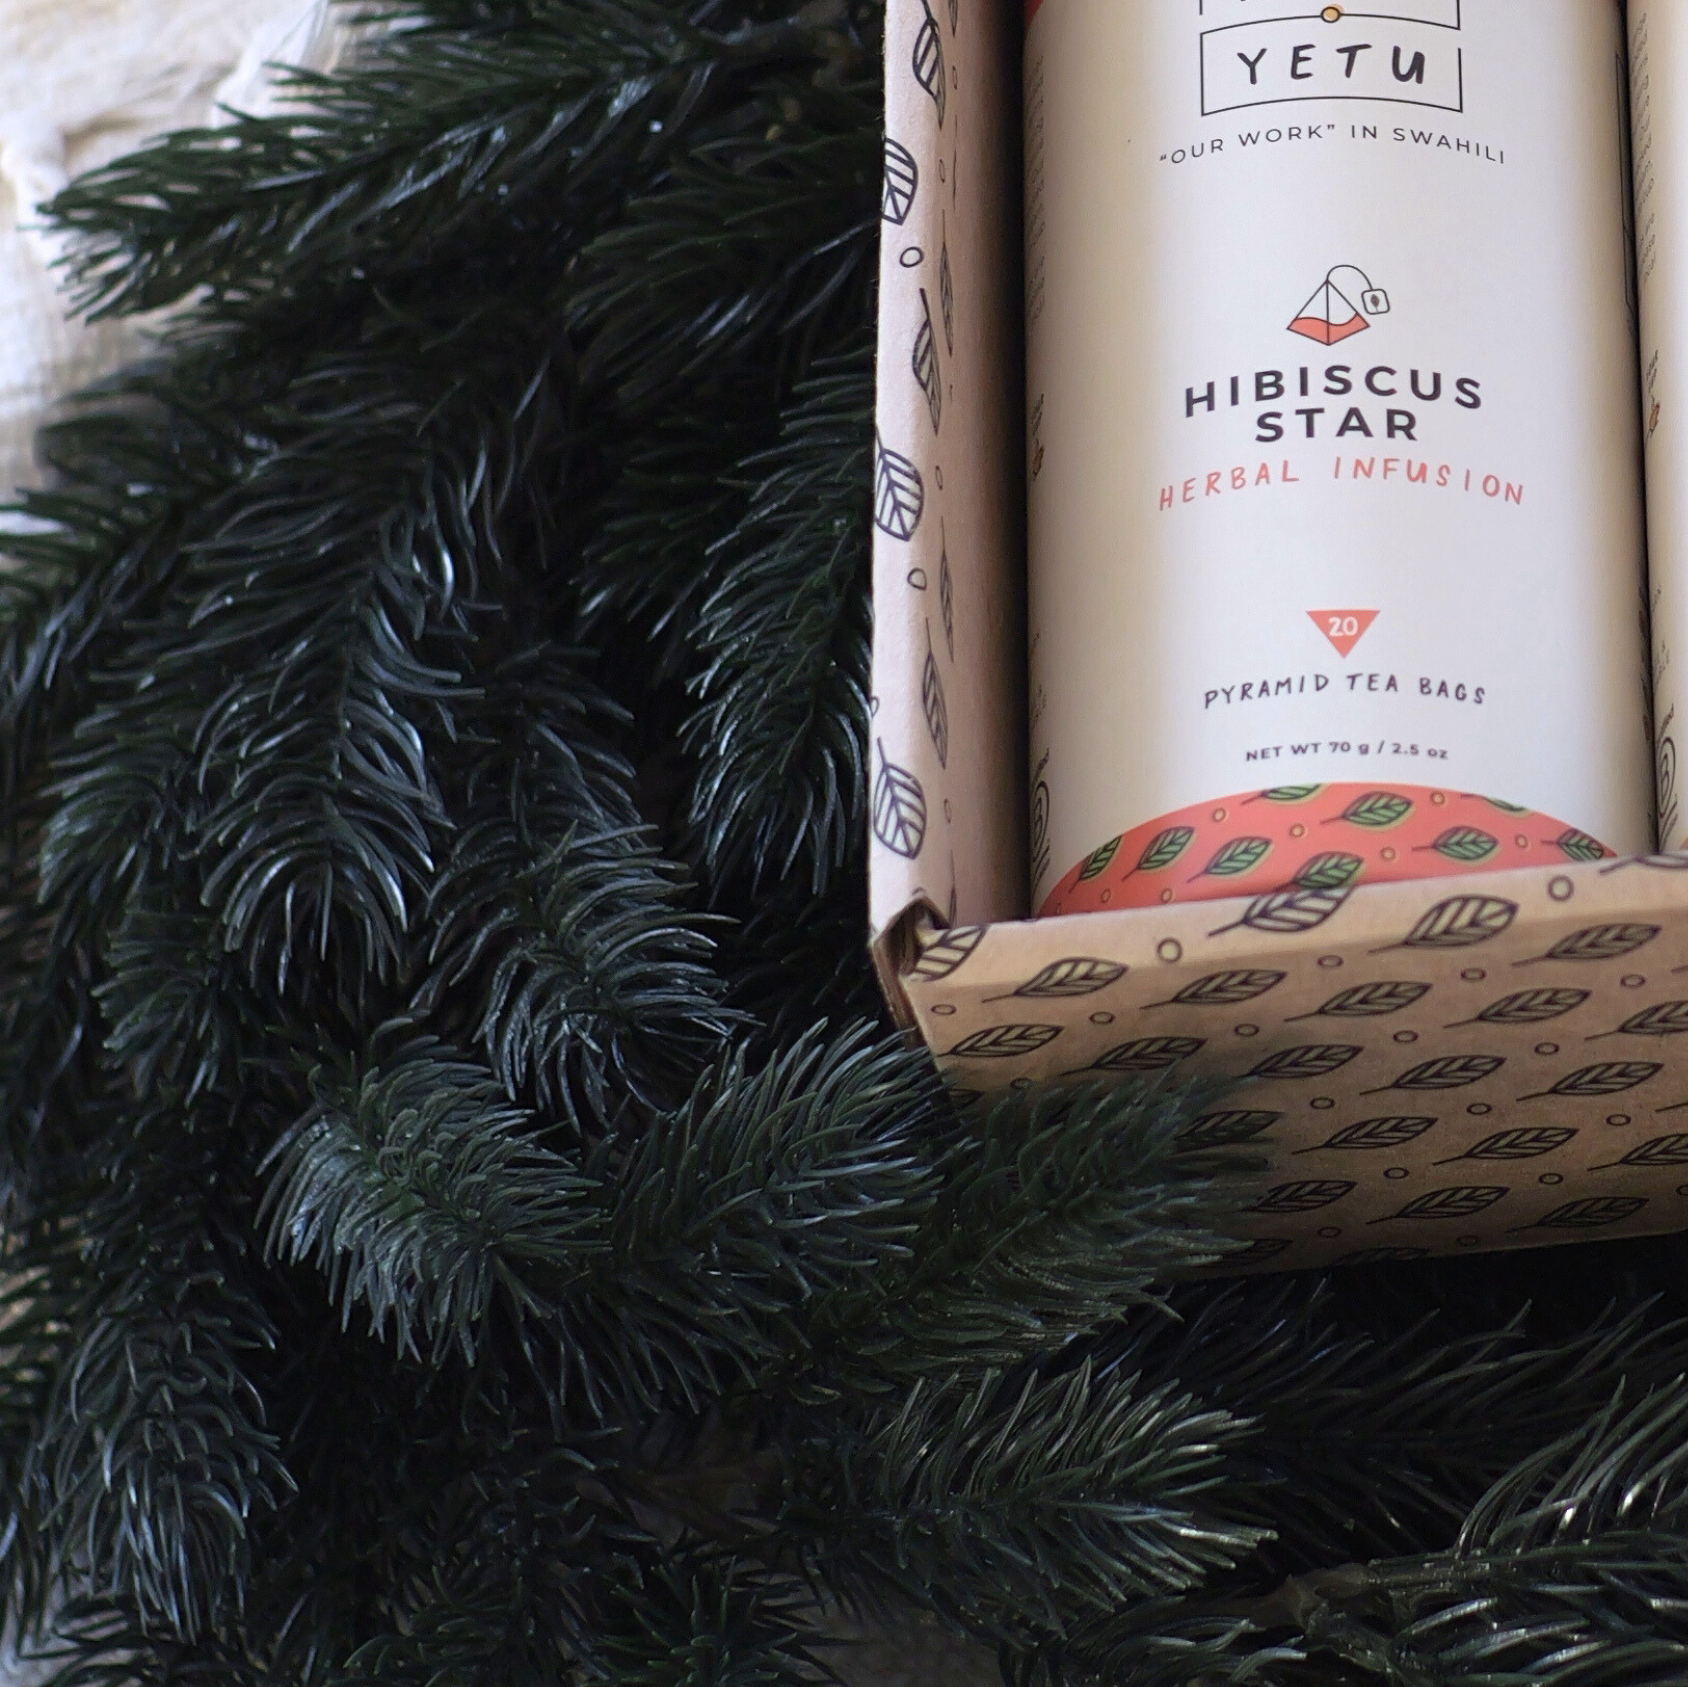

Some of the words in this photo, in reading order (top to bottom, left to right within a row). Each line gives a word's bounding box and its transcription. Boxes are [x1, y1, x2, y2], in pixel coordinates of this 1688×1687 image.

[1237, 44, 1425, 84] YETU
[1351, 125, 1377, 139] IN
[1394, 128, 1504, 163] SWAHILI
[1185, 365, 1481, 418] HIBISCUS
[1255, 408, 1417, 442] STAR
[1159, 461, 1299, 510] HERBAL
[1334, 457, 1523, 505] INFUSION
[1328, 617, 1358, 637] 20
[1204, 675, 1329, 708] PYRAMID
[1347, 674, 1398, 692] TEA
[1420, 678, 1486, 704] BAGS
[1247, 746, 1282, 761] NET
[1291, 743, 1321, 755] WT
[1329, 742, 1350, 753] 70
[1392, 743, 1418, 755] 2.5
[1428, 748, 1448, 759] oz
